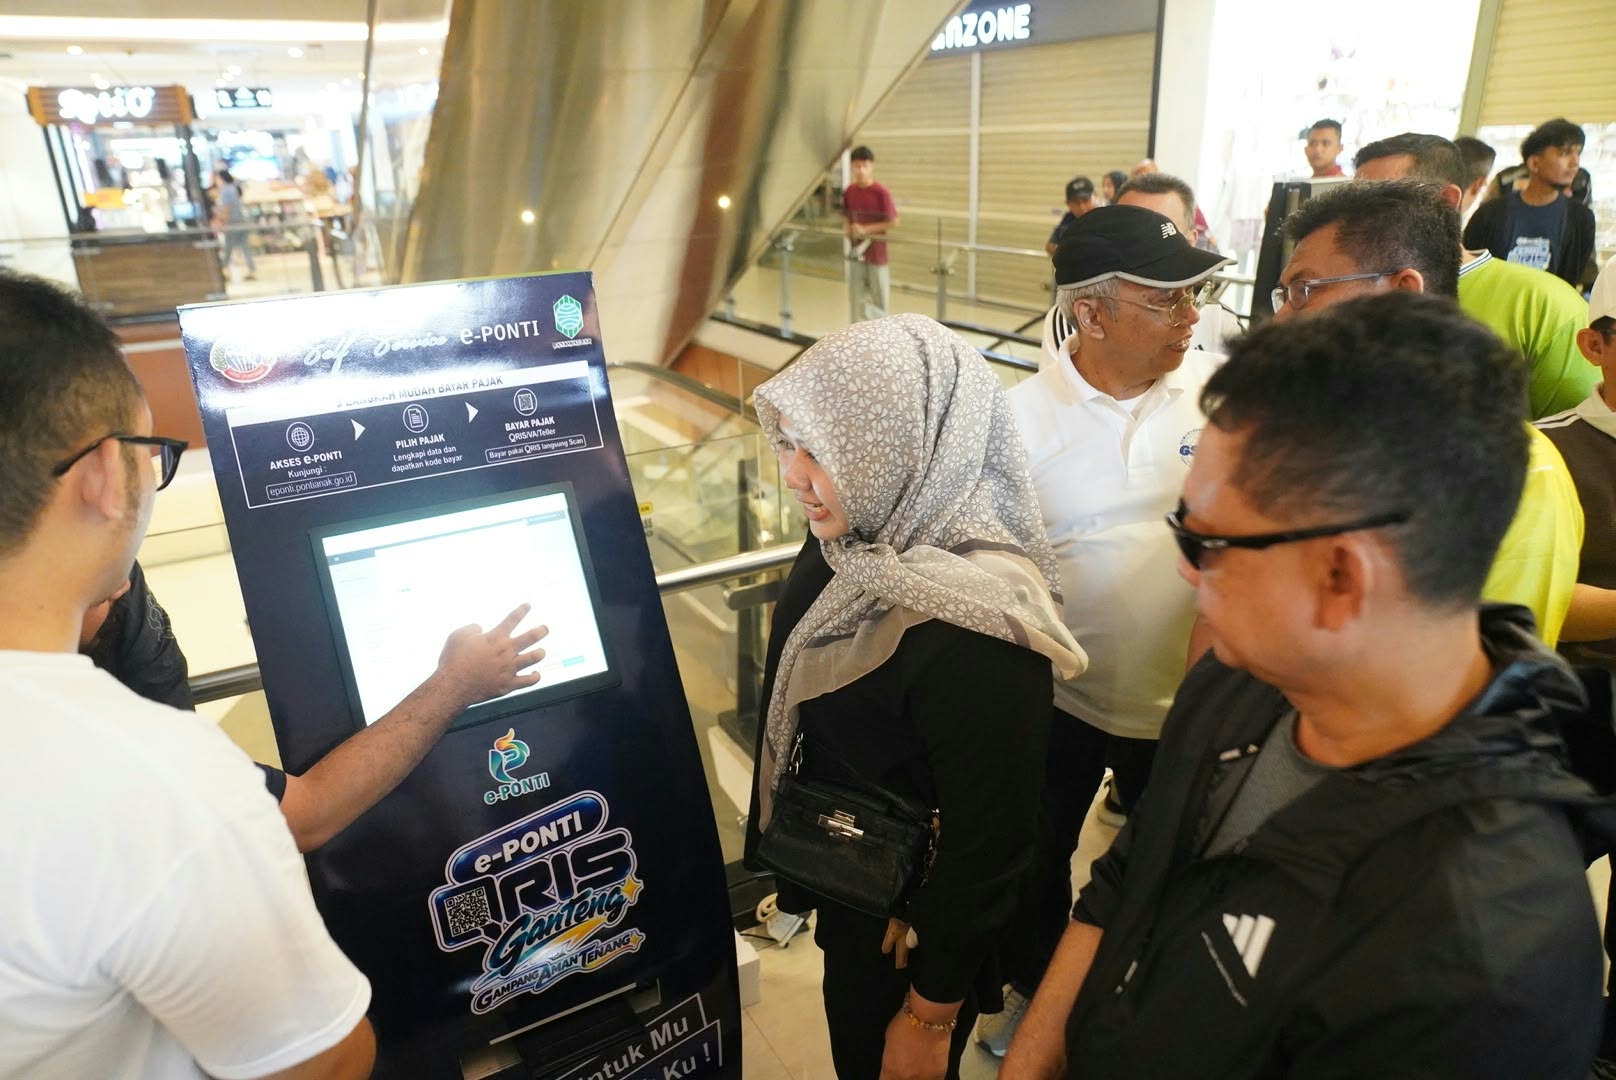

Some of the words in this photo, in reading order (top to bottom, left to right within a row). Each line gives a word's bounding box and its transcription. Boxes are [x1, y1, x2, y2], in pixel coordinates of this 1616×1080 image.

[459, 320, 540, 345] e-PONTI
[472, 376, 504, 389] PAJAK
[505, 419, 530, 431] BAYAR
[531, 416, 555, 427] PAJAK
[395, 438, 418, 449] PILIH
[419, 434, 445, 445] PAJAK
[508, 428, 556, 442] QRIS/VA/Teller
[393, 450, 426, 462] Lengkapi
[427, 448, 442, 456] data
[443, 446, 456, 454] dan
[489, 449, 507, 459] Bayar
[507, 448, 524, 457] pakai
[524, 444, 541, 454] QRIS
[541, 440, 568, 450] langsung
[568, 438, 584, 446] Scan
[270, 457, 302, 470] AKSES
[303, 450, 343, 464] e-PONTI
[391, 461, 424, 472] dapatkan
[425, 458, 442, 467] kode
[443, 455, 463, 464] bayar
[288, 465, 323, 478] Kunjungi
[269, 474, 353, 496] eponti.pontianak.go.id
[484, 772, 550, 805] e-PONTI
[474, 810, 583, 874] e-PONTI
[430, 829, 636, 951] QRIS
[475, 970, 540, 1010] GAMPANG
[534, 954, 578, 990] AMAN
[578, 934, 632, 967] TENANG
[578, 1043, 646, 1080] ntuk
[650, 1016, 690, 1051] Mu
[663, 1055, 697, 1080] Ku
